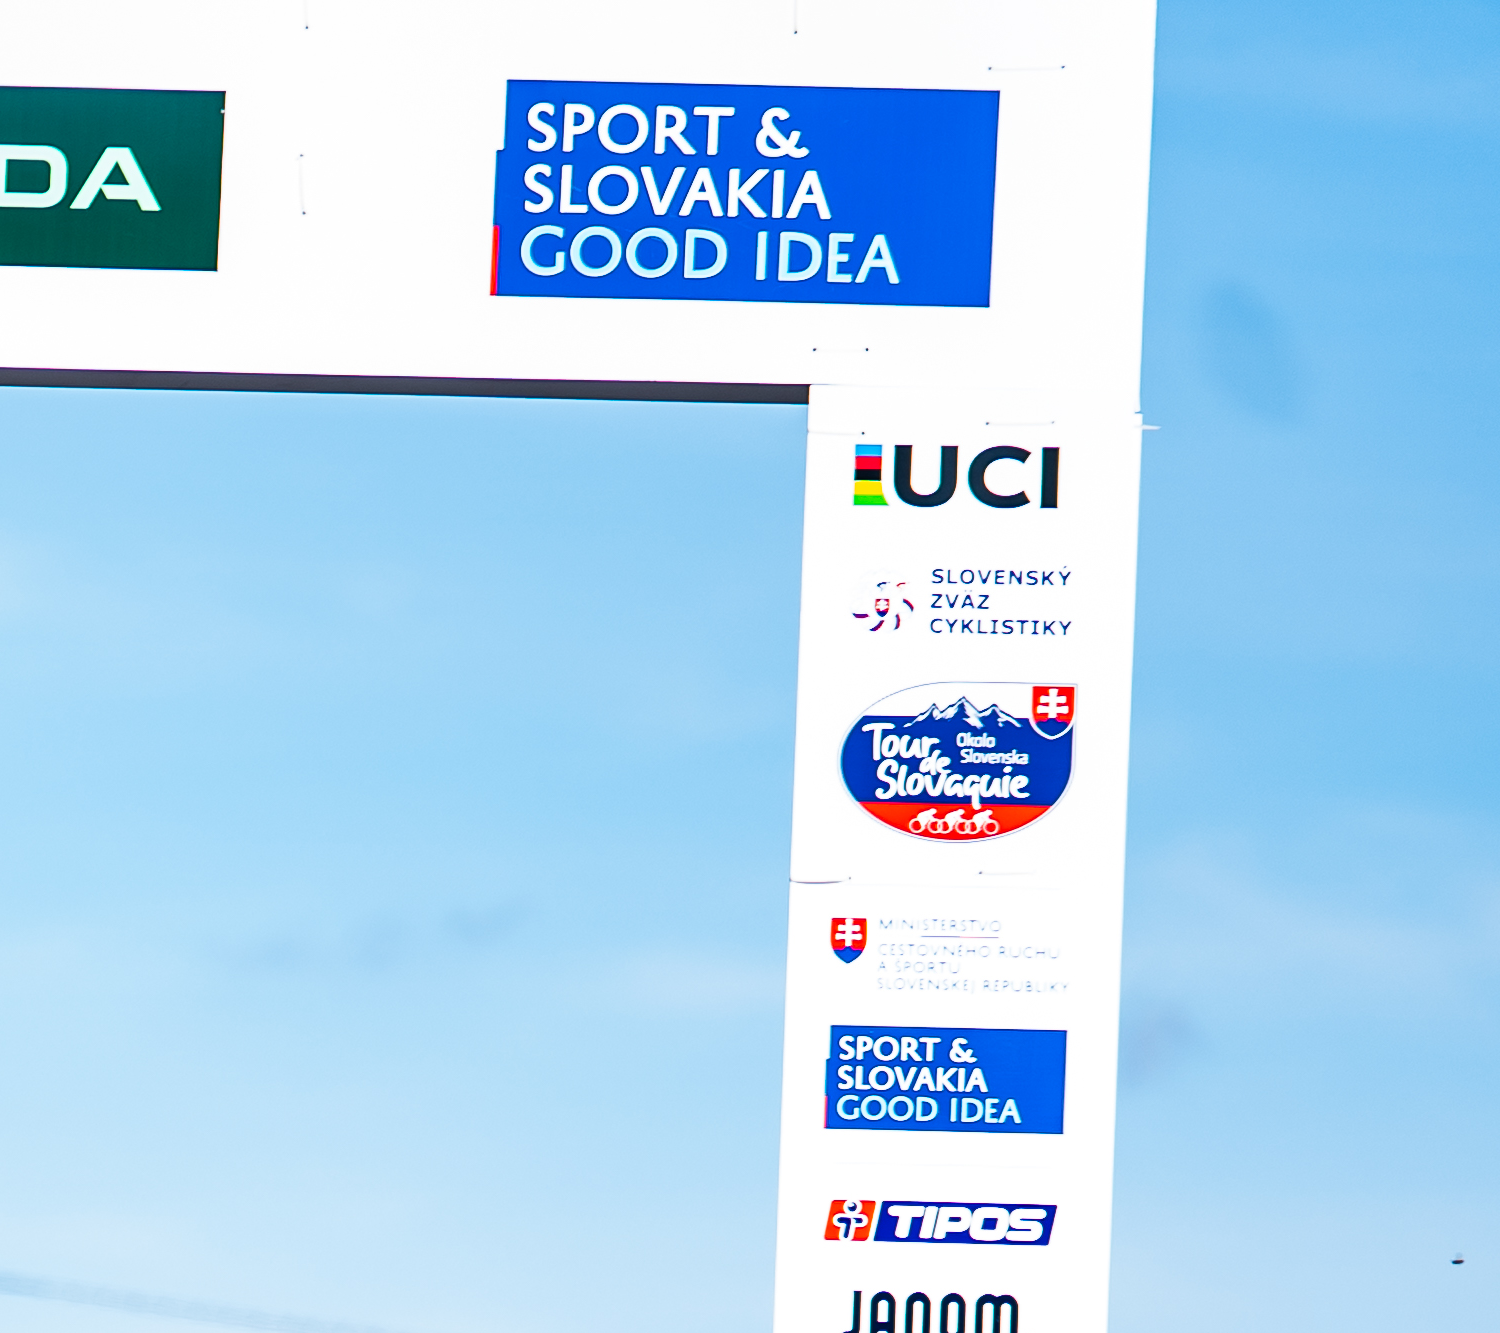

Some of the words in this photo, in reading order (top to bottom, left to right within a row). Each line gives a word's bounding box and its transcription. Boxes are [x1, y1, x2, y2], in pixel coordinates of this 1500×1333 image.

[527, 102, 735, 156] SPORT
[755, 107, 810, 158] &
[524, 164, 831, 219] SLOVAKIA
[520, 225, 728, 279] GOOD
[755, 231, 900, 284] IDEA
[893, 445, 1060, 508] UCI
[931, 566, 1071, 587] SLOVENSKÝ
[931, 590, 990, 610] ZVÄZ
[930, 619, 1072, 635] CYKLISTIKY
[862, 723, 940, 760] Tour
[956, 732, 996, 748] Okolo
[919, 750, 951, 775] de
[960, 749, 1029, 764] Slovenska
[875, 759, 1030, 810] Slovaquie
[879, 918, 1001, 931] MINISTERSTVO
[838, 1035, 941, 1063] SPORT
[949, 1037, 978, 1063] &
[837, 1065, 988, 1093] SLOVAKIA
[836, 1095, 938, 1122] GOOD
[950, 1097, 1022, 1124] IDEA
[887, 1204, 1047, 1243] TIPOS
